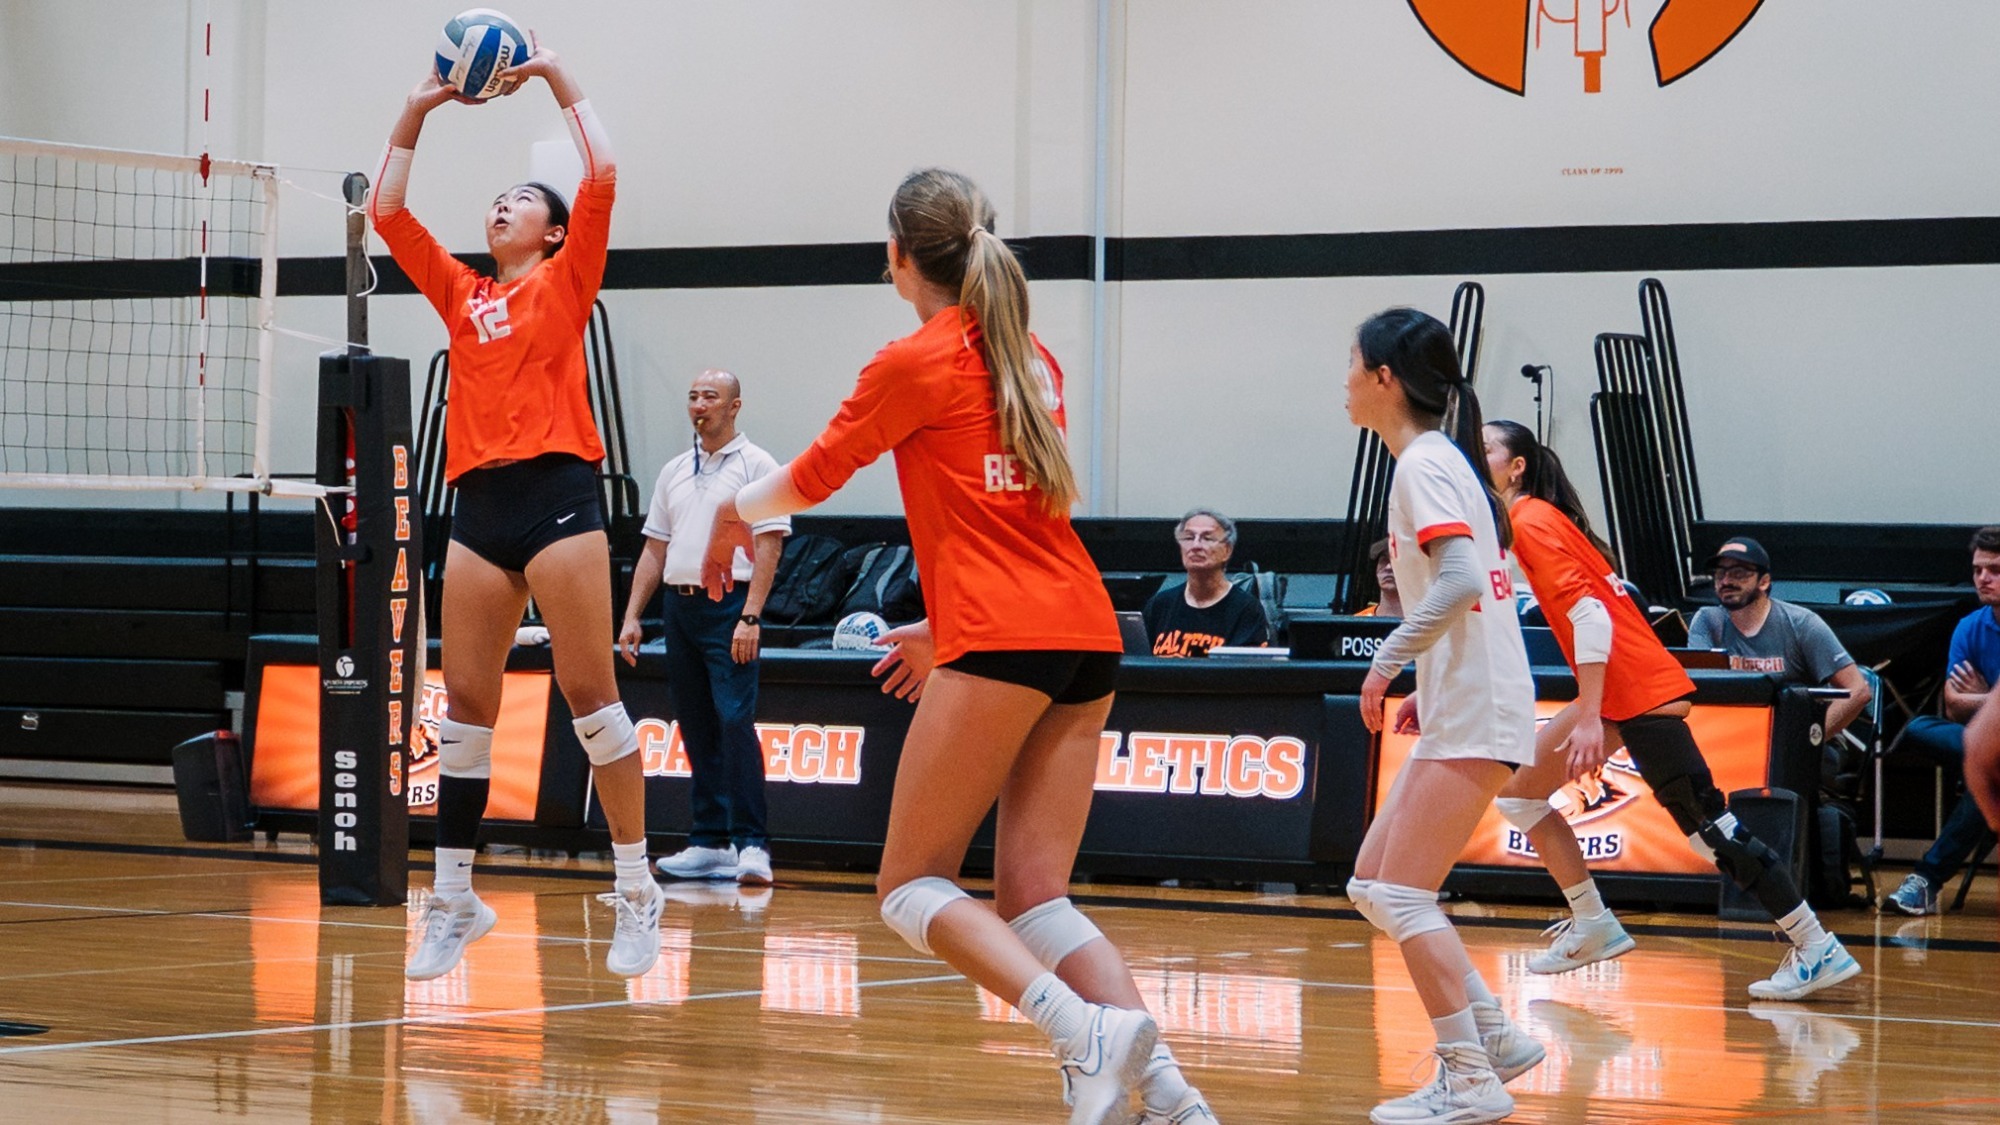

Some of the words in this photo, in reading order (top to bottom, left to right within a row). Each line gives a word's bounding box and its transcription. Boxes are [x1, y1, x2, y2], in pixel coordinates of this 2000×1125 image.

[484, 45, 511, 92] moen
[1561, 168, 1588, 176] CLASS
[1590, 167, 1601, 175] OF
[469, 297, 512, 344] 12
[389, 445, 411, 796] BEAVERS
[635, 718, 865, 784] CAECH
[1093, 731, 1306, 799] LETICS
[334, 750, 358, 851] senoh
